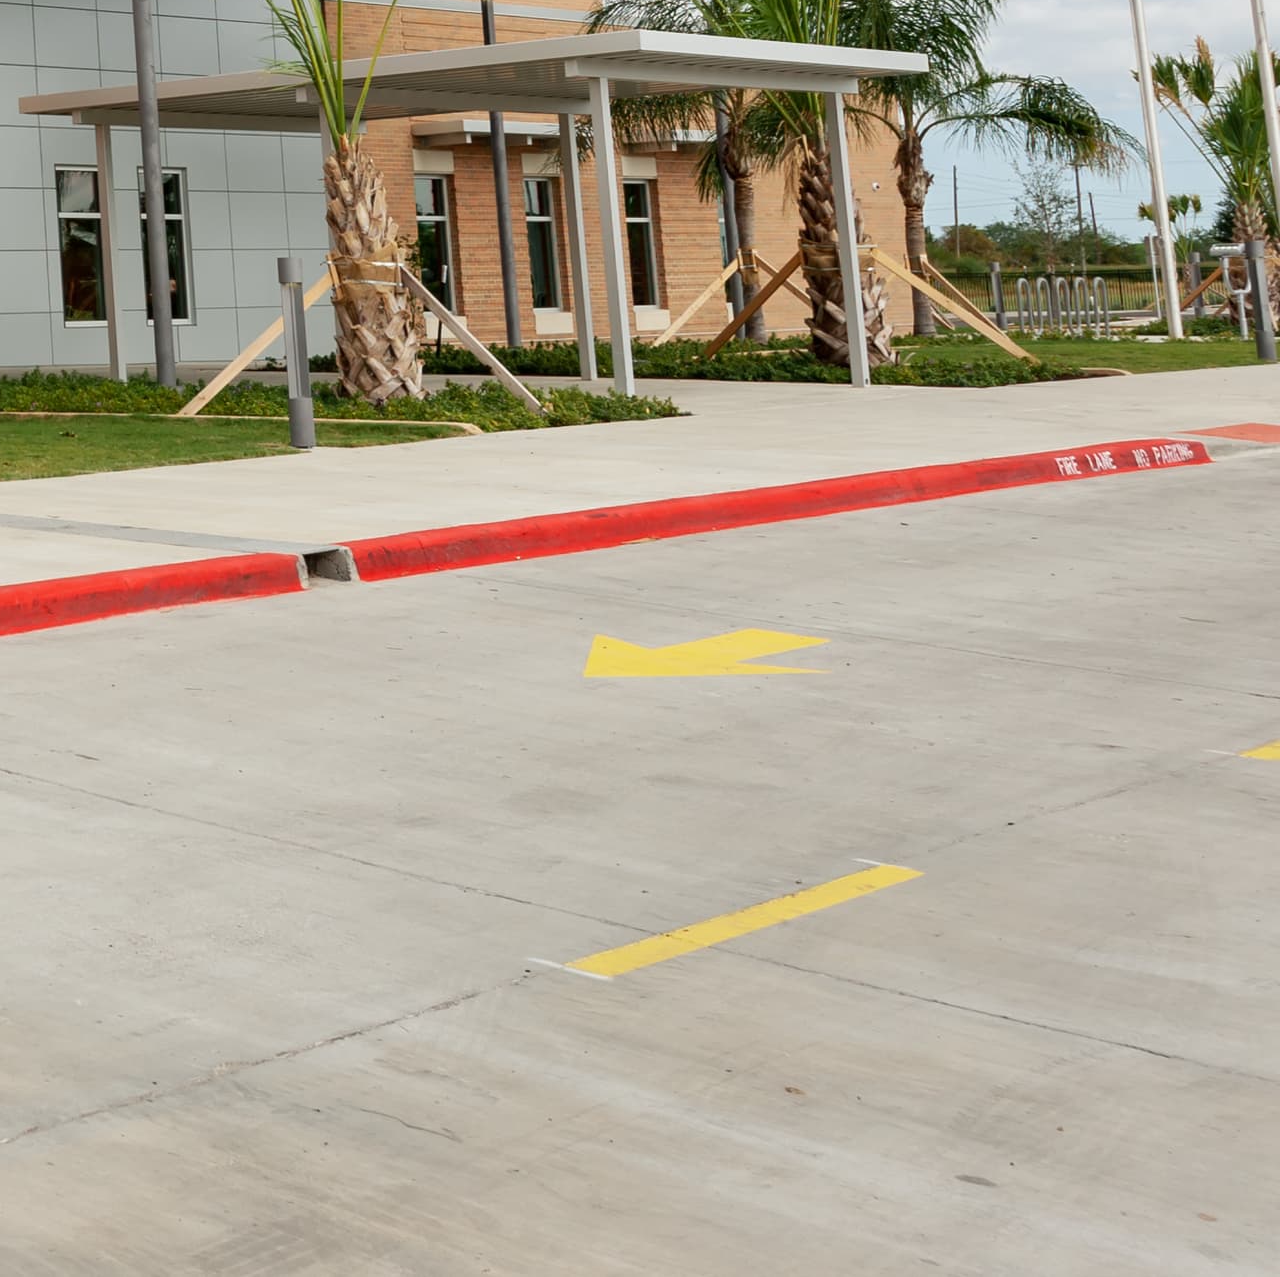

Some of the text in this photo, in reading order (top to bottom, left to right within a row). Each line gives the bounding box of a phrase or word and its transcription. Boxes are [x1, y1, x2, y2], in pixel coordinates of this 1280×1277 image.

[1055, 442, 1195, 476] FIRE LANE NO PARKING
